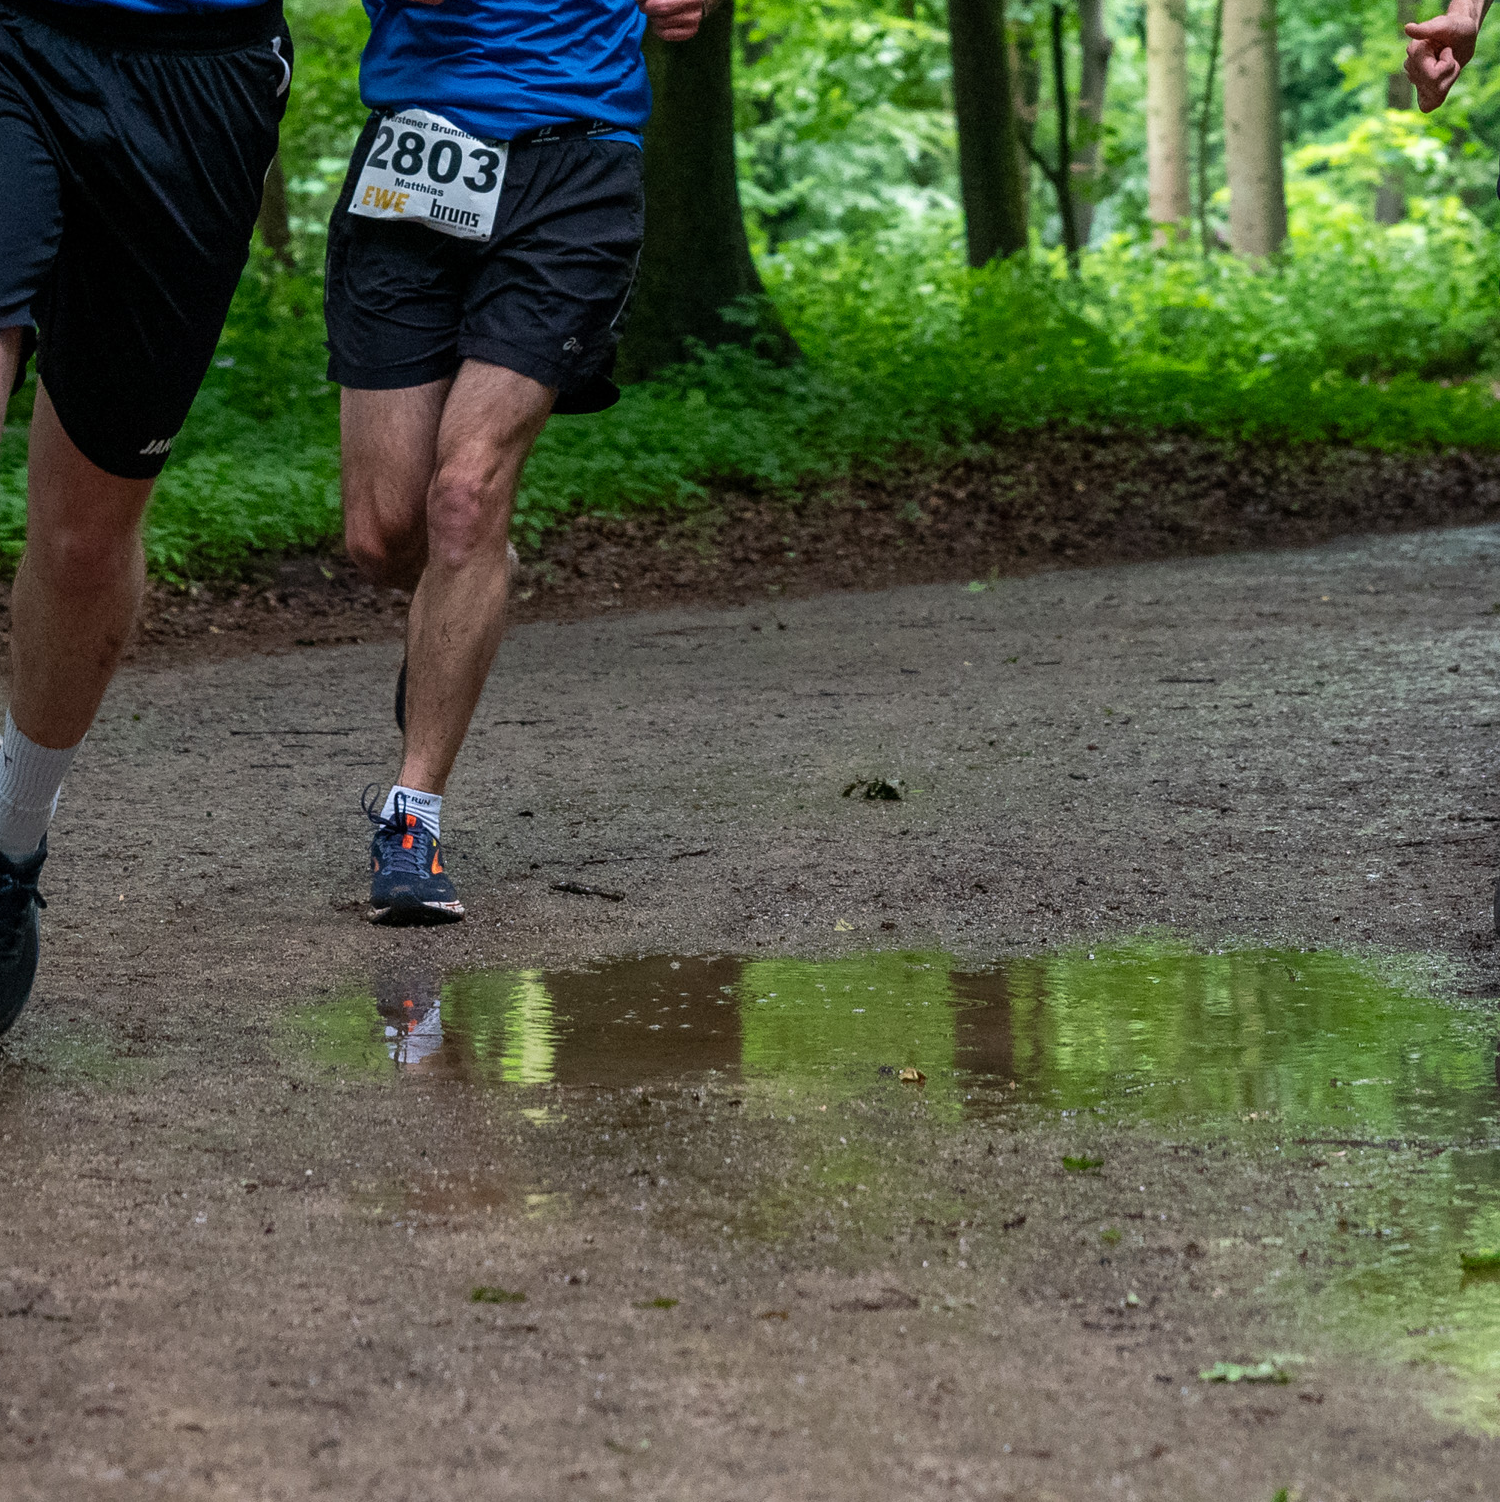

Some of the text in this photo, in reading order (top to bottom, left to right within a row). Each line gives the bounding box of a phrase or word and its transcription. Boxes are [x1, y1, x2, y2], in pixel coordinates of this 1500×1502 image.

[385, 114, 429, 130] erstener
[366, 126, 500, 193] 2803
[394, 177, 445, 197] Matthias
[361, 185, 410, 213] EWE
[429, 198, 480, 228] bruns
[411, 796, 431, 806] RUN
